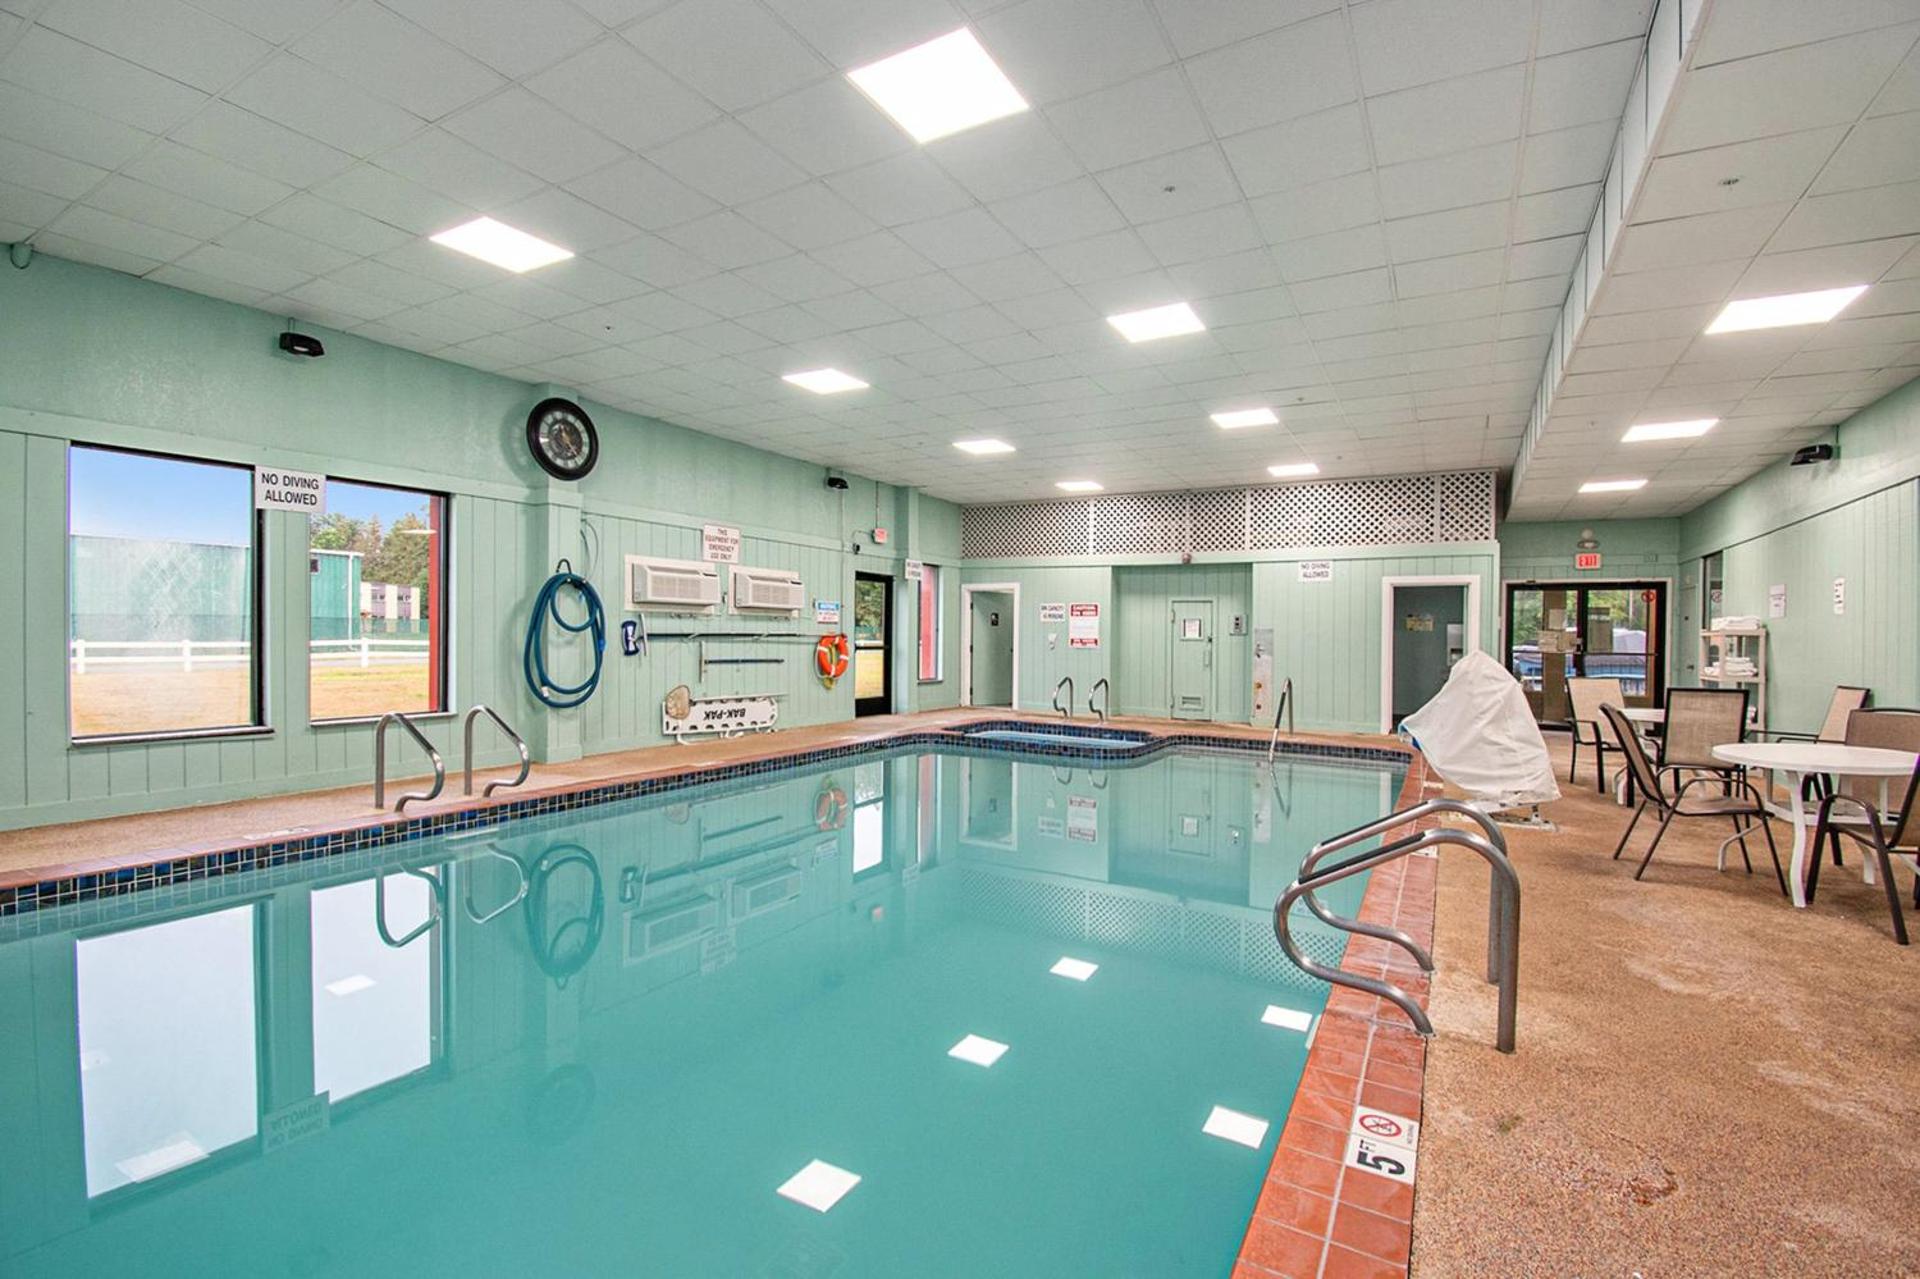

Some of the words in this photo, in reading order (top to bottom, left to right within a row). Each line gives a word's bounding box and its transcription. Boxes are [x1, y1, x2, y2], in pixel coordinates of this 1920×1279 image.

[261, 473, 278, 485] NO
[283, 475, 319, 490] DIVING
[265, 489, 317, 506] ALLOWED
[705, 534, 729, 543] EQUIPMENT
[709, 543, 734, 552] EMERGENCY
[1301, 562, 1310, 570] NO
[1311, 562, 1330, 570] DIVING
[1578, 555, 1597, 567] EXIT
[1303, 570, 1329, 578] ALLOWED
[704, 708, 746, 720] BAK-PAK
[1357, 1151, 1405, 1175] 5
